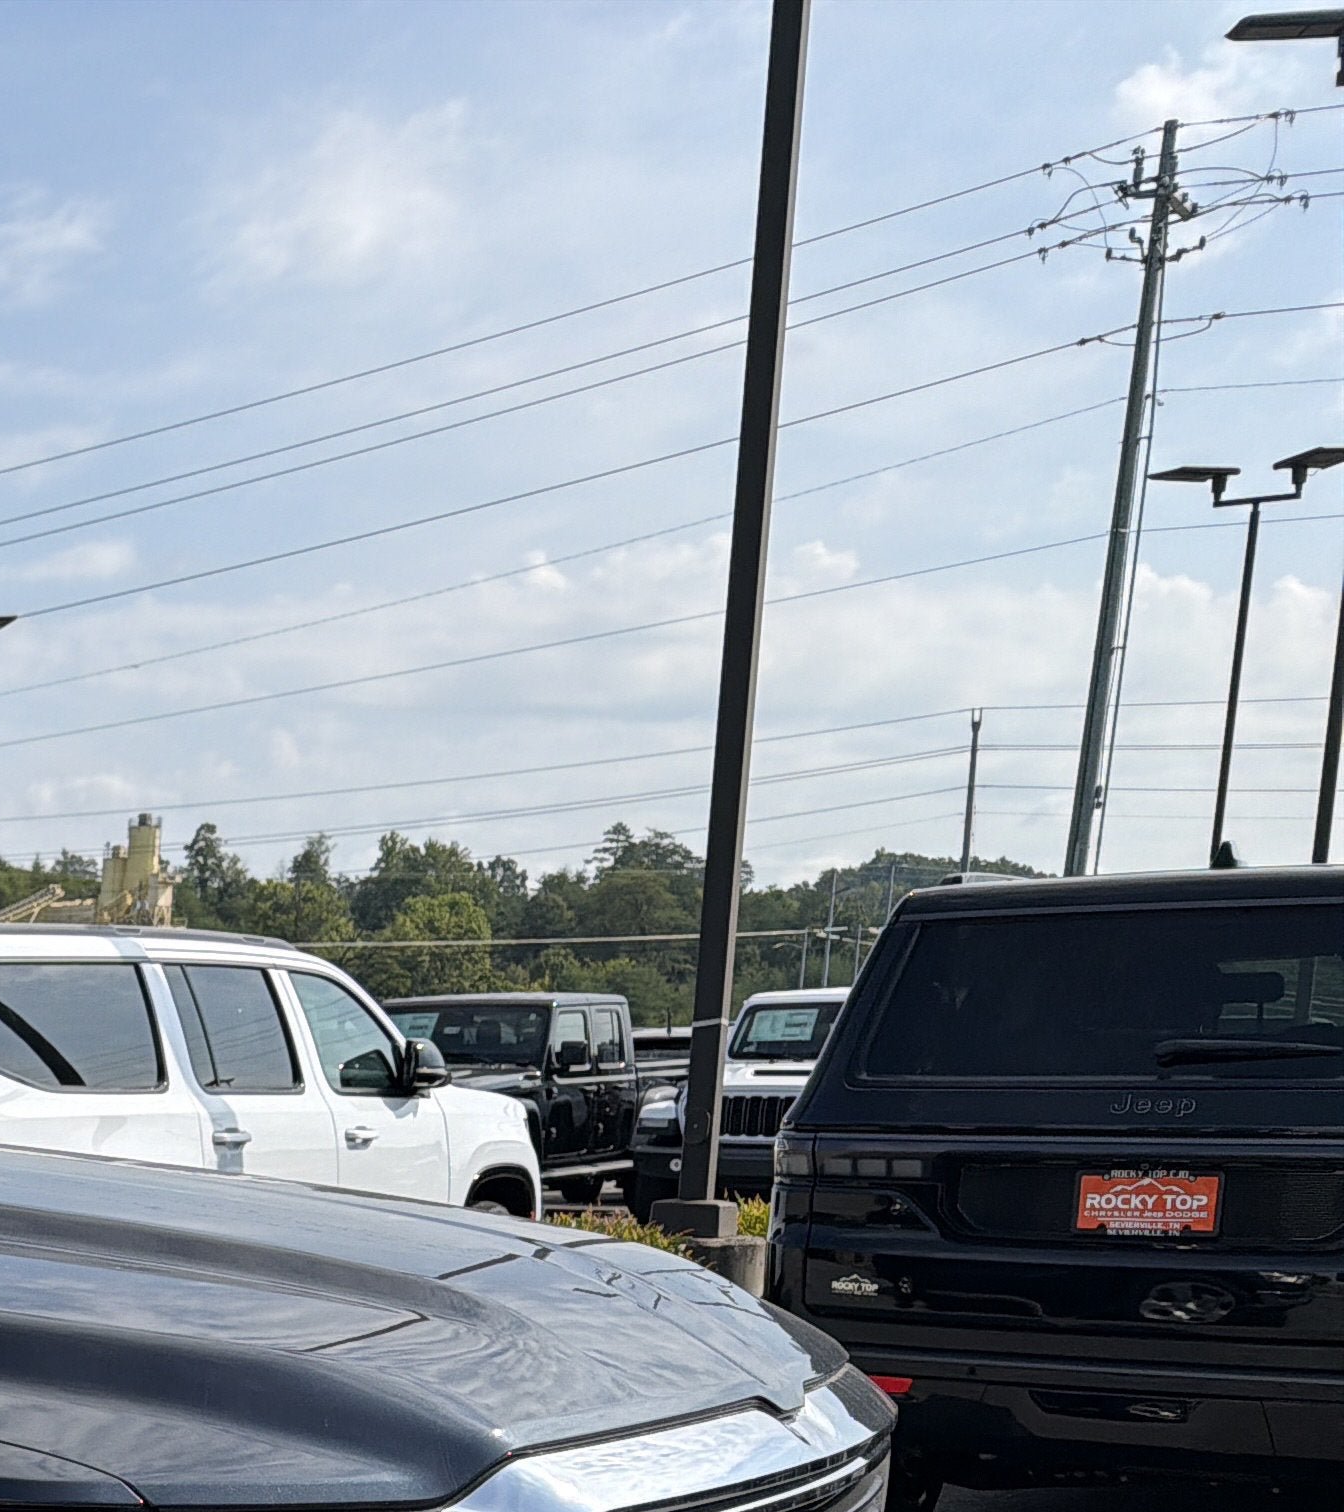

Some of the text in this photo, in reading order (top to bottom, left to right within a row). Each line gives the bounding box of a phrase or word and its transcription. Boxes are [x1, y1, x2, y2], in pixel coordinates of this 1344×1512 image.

[1110, 1094, 1196, 1117] Jeep
[1111, 1170, 1144, 1178] ROCKY
[1148, 1169, 1167, 1179] TOP
[1086, 1193, 1208, 1210] ROCKY TOP
[1142, 1210, 1163, 1218] Jeep
[1169, 1222, 1181, 1230] TN
[831, 1281, 878, 1292] ROCKY TOP
